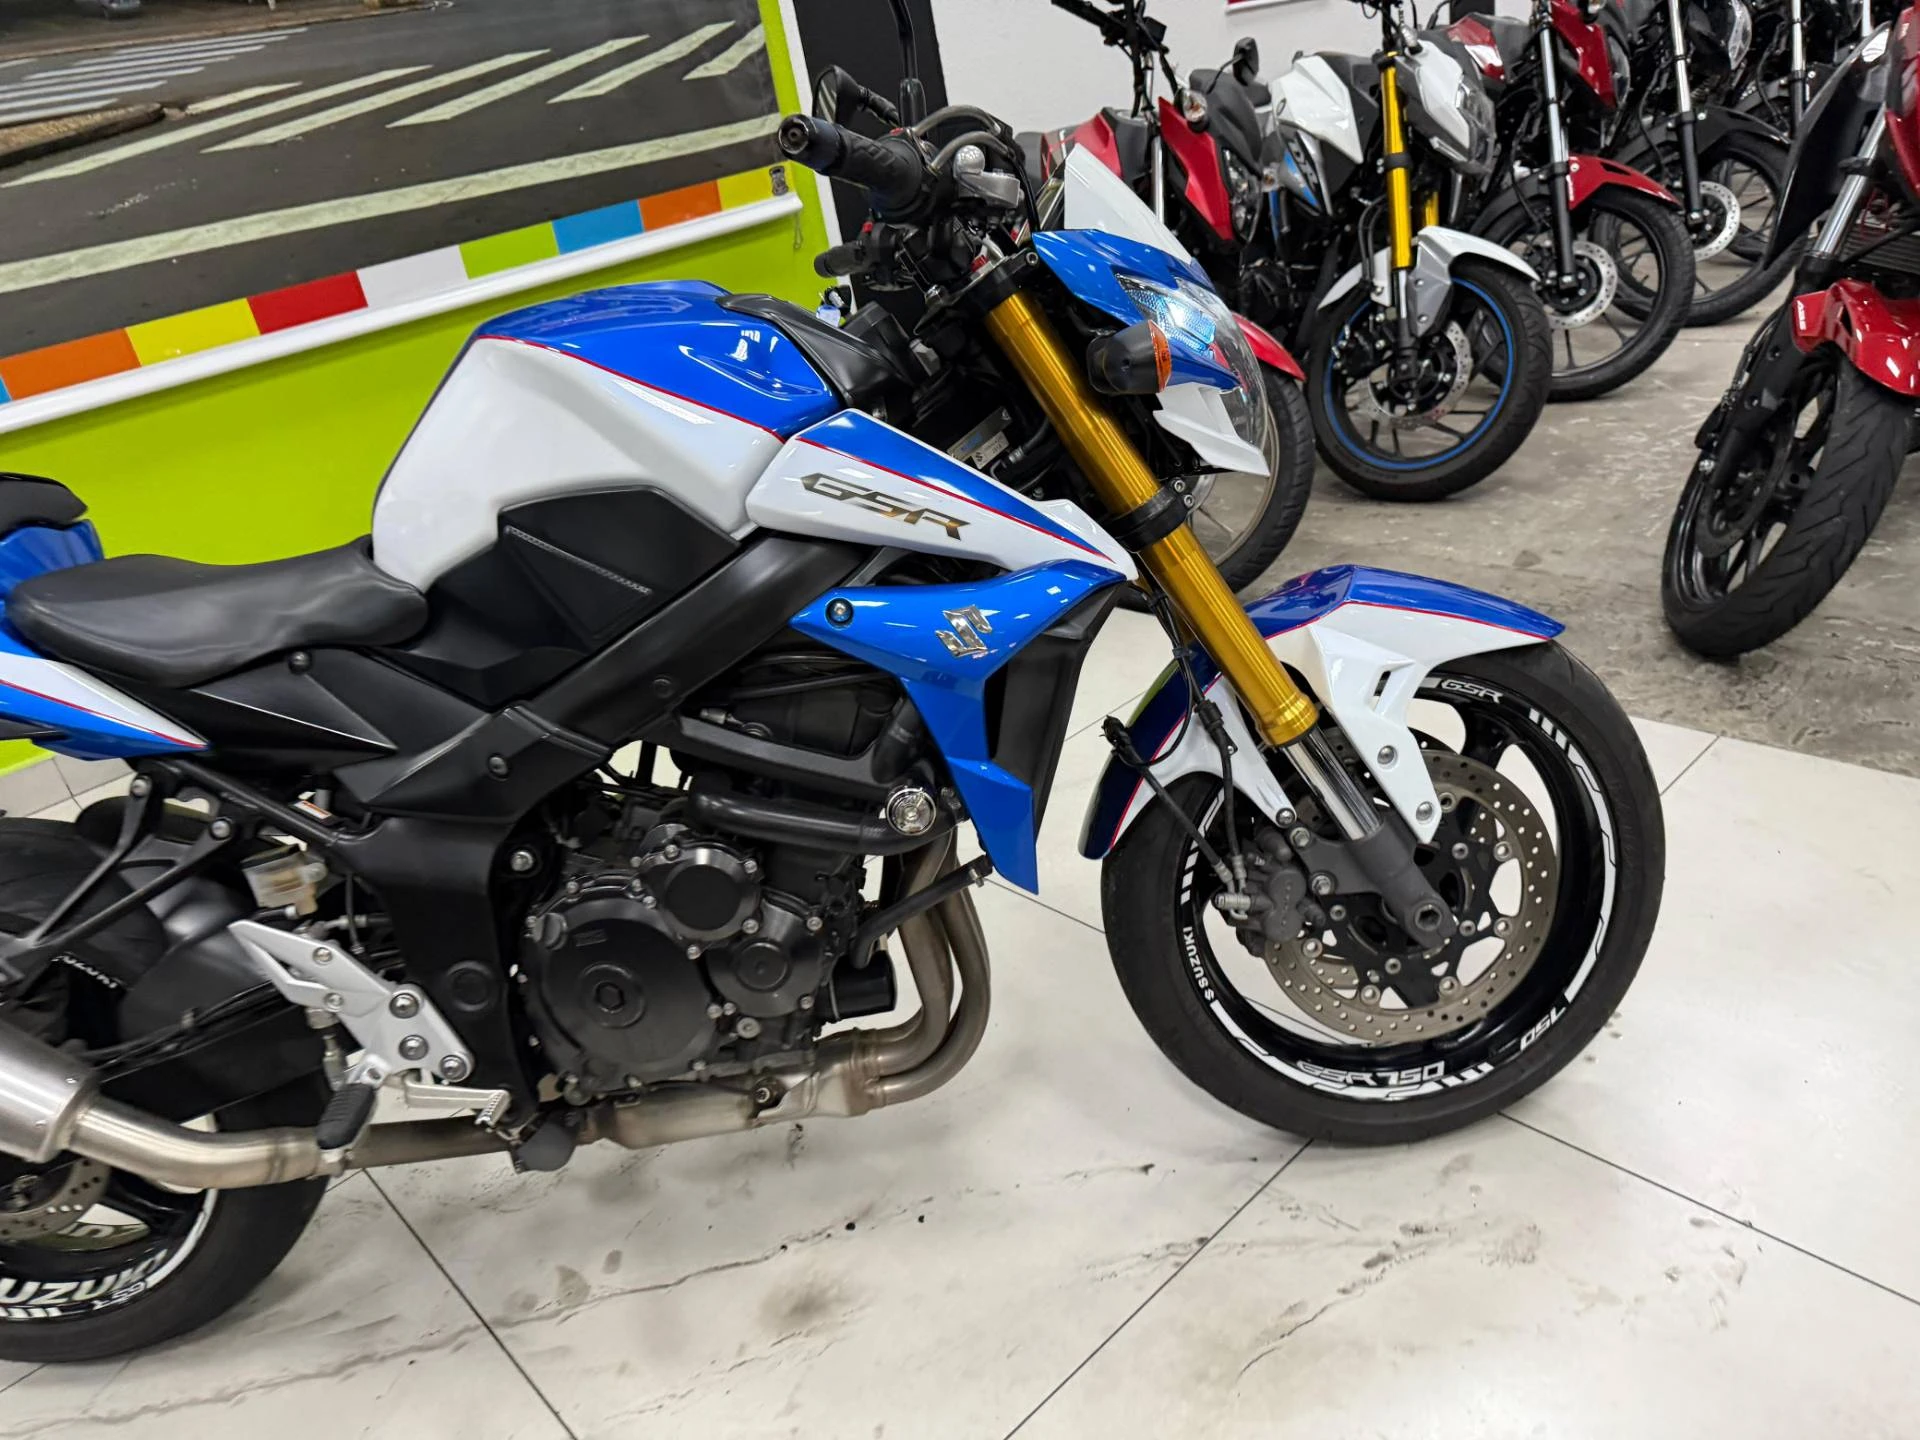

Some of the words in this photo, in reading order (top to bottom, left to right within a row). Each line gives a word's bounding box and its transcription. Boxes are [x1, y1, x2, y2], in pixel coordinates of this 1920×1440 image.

[800, 472, 971, 541] GSR
[1440, 679, 1504, 704] GSR
[1182, 926, 1209, 989] SUZUKI
[1520, 1006, 1567, 1052] 750
